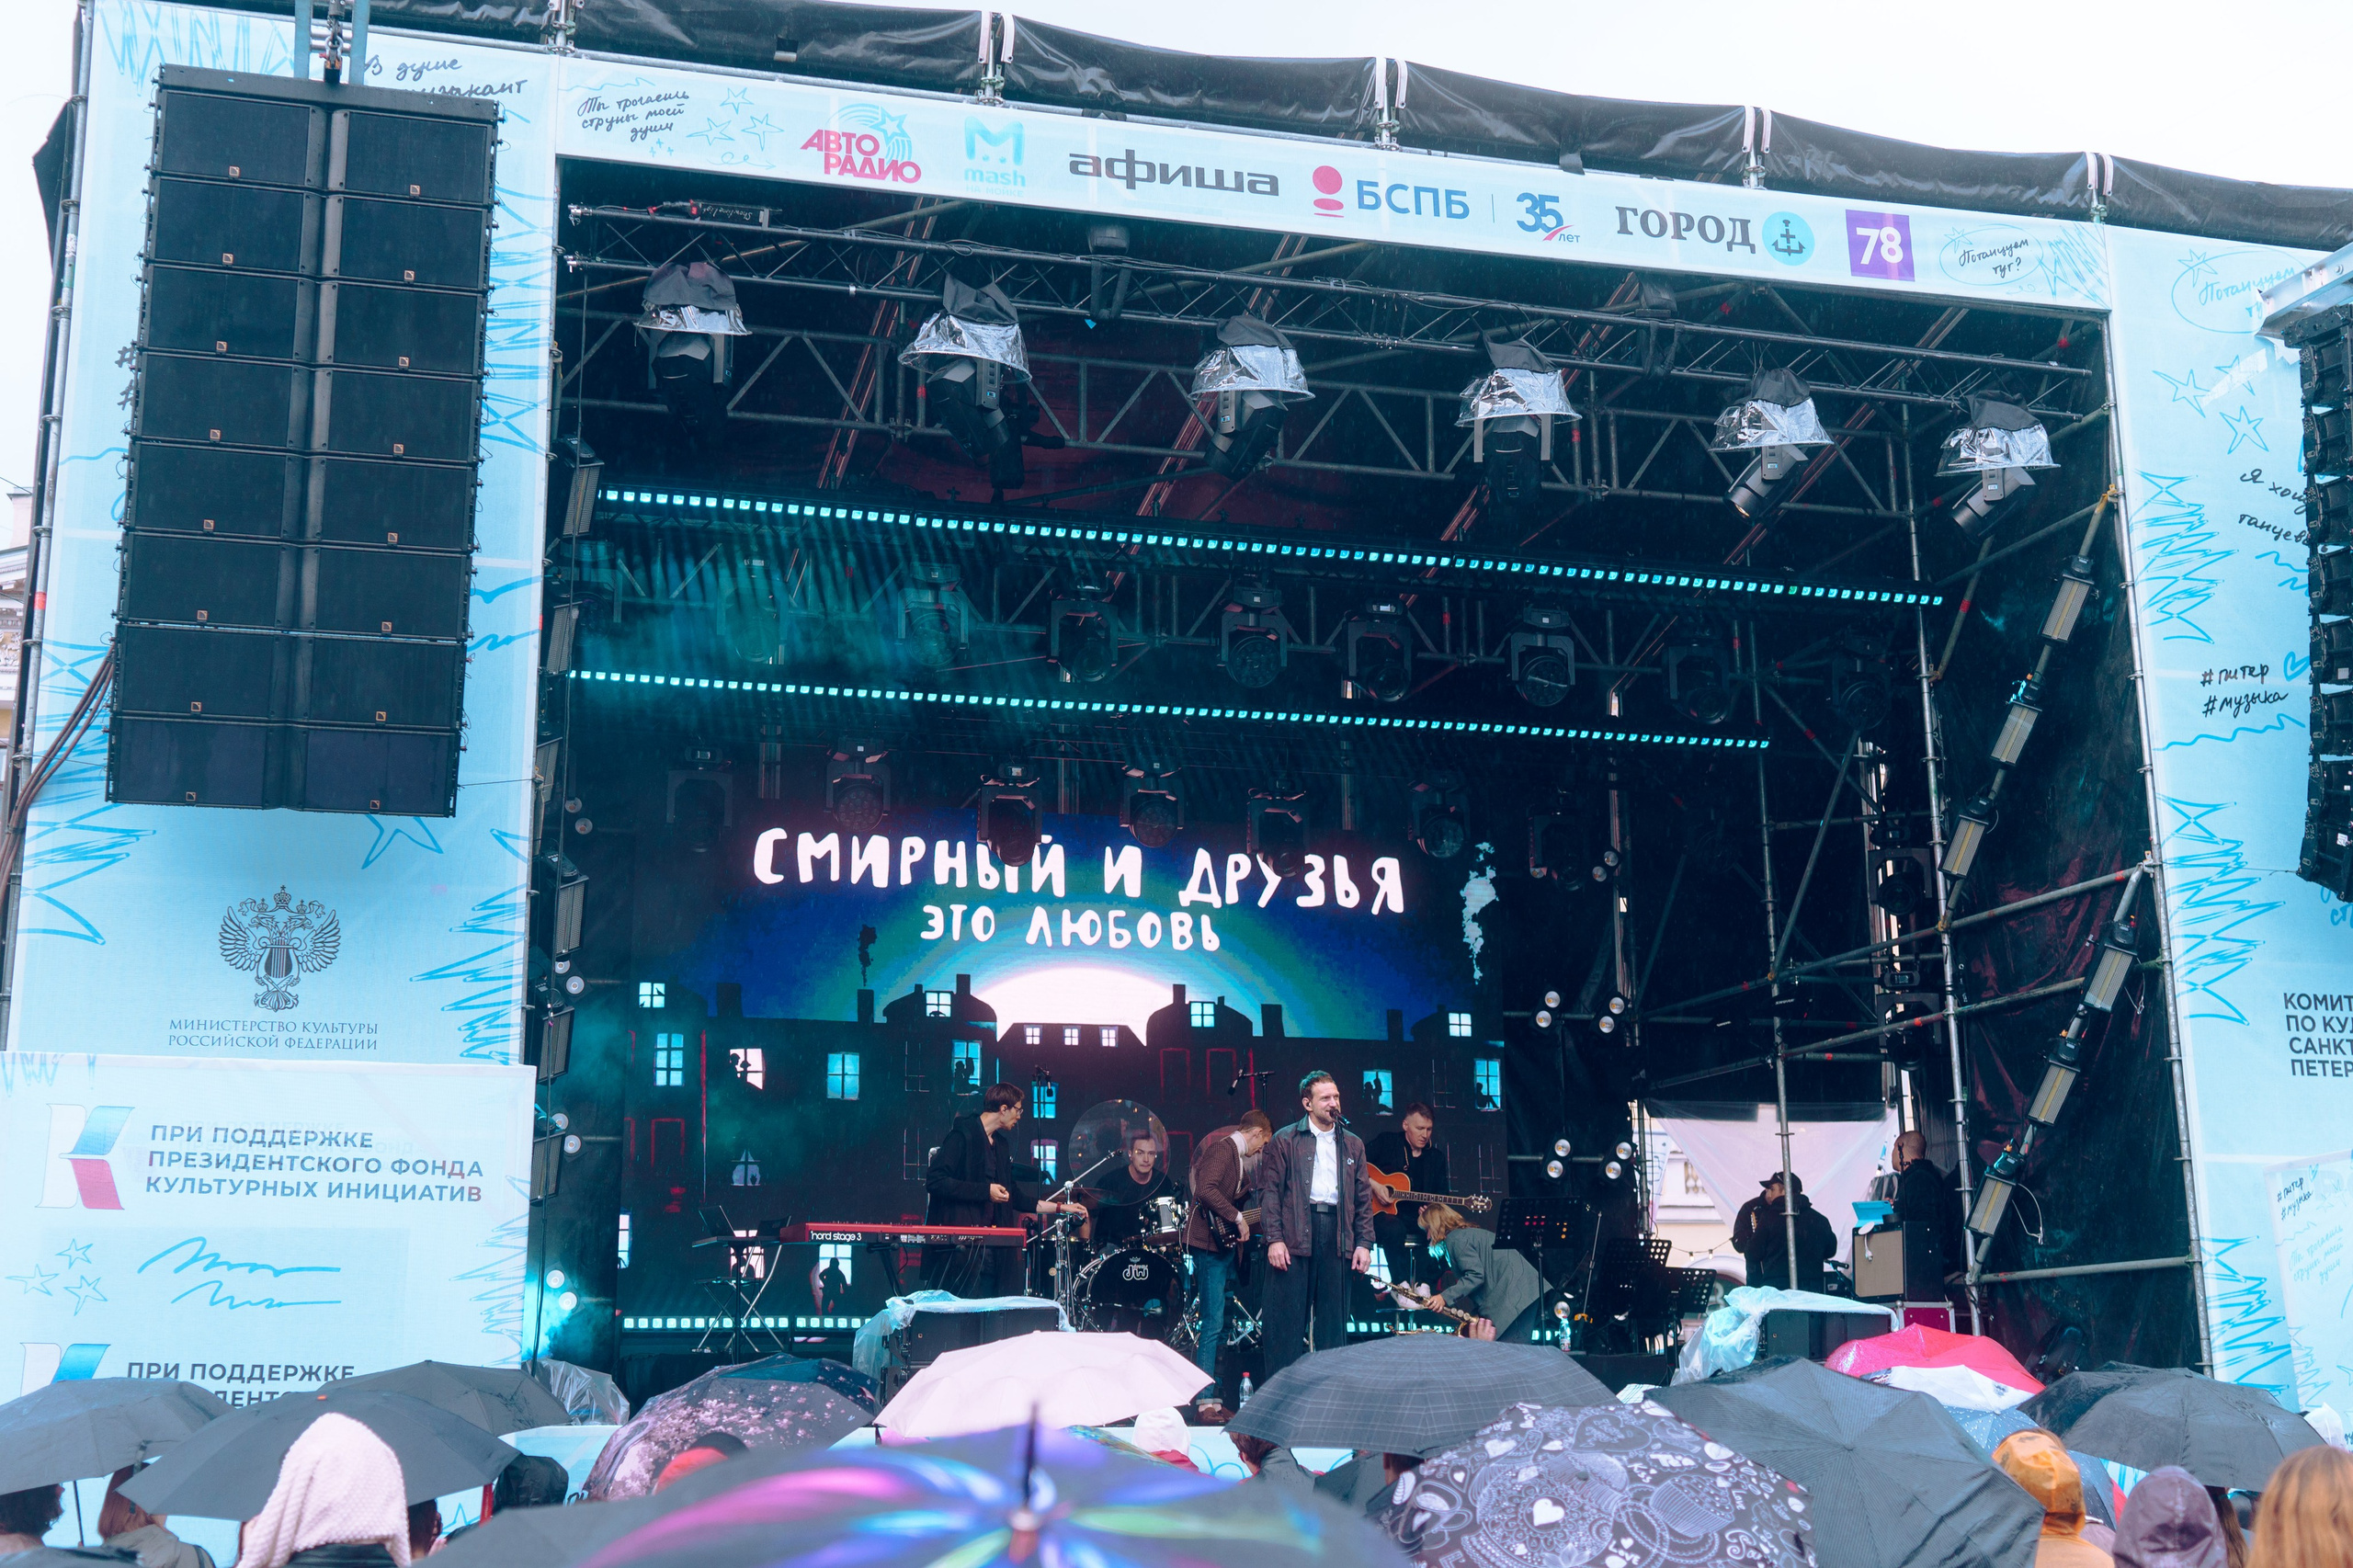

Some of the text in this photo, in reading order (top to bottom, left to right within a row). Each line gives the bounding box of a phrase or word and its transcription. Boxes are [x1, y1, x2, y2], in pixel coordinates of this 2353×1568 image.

[396, 58, 462, 82] душе
[577, 91, 689, 117] Ты трогаешь
[582, 103, 685, 131] струны моей
[800, 129, 880, 156] АВТО
[824, 152, 922, 184] РАДИО
[964, 167, 1027, 187] mash
[1068, 149, 1279, 197] афиша
[1357, 179, 1581, 244] БСПБ 35 лет
[1614, 206, 1756, 254] ГОРОД
[1855, 225, 1904, 266] 78
[1959, 239, 2029, 267] Потанцуем
[1992, 256, 2021, 278] тут?
[2240, 469, 2264, 483] Я
[2200, 664, 2269, 687] #питер
[2202, 690, 2289, 719] #музыка
[754, 827, 1404, 915] СМИРНЫЙ И ДРУЗЬЯ
[921, 904, 1221, 952] ЭТО ЛЮБОВЬ
[169, 1019, 378, 1034] МИНИСТЕРСТВО КУЛЬТУРЫ
[2286, 1015, 2353, 1034] ПО КУ
[168, 1034, 378, 1051] РОССИЙСКОЙ ФЕДЕРАЦИИ
[151, 1124, 203, 1143] ПРИ
[212, 1127, 373, 1148] ПОДДЕРЖКЕ
[148, 1151, 483, 1179] ПРЕЗИДЕНТСКОГО ФОНДА
[145, 1176, 483, 1203] КУЛЬТУРНЫХ ИНИЦИАТИВ
[811, 1231, 862, 1243] nord stage 3
[127, 1362, 355, 1384] ПРИ ПОДДЕРЖКЕ
